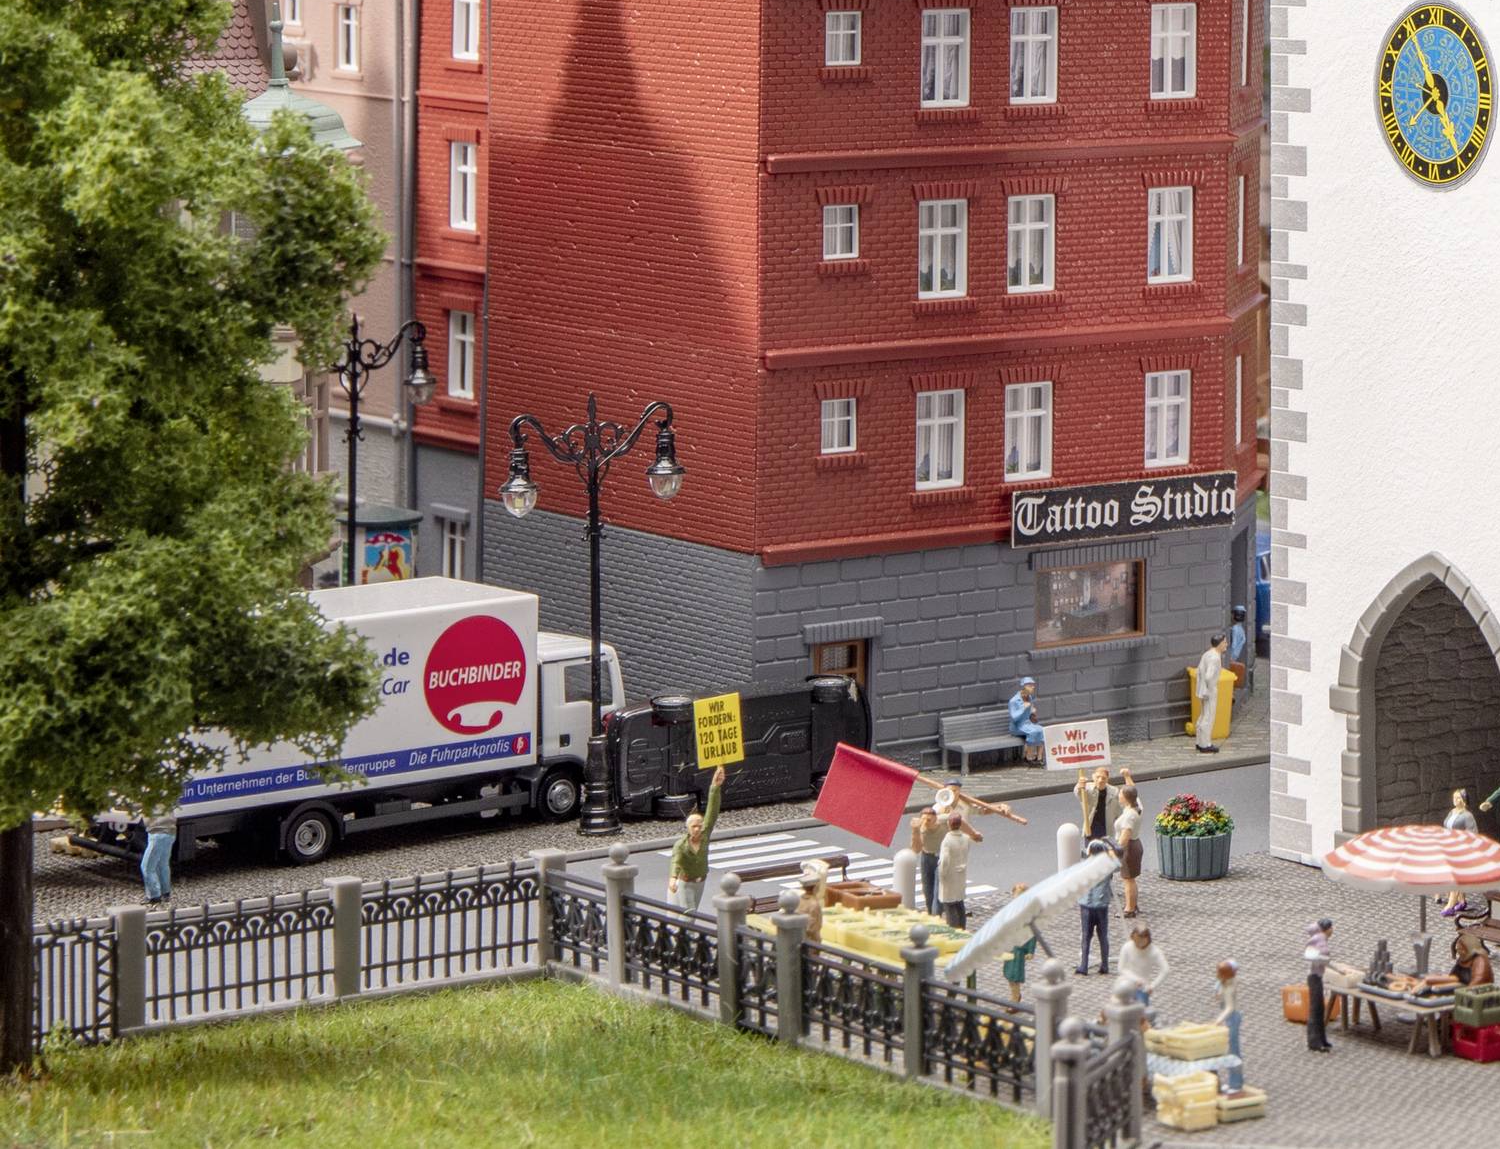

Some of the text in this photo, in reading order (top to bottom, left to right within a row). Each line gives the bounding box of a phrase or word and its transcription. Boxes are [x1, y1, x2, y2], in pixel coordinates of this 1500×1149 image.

[1015, 480, 1236, 536] Tattoo Studio
[428, 660, 522, 690] BUCHBINDER
[382, 677, 411, 695] Car
[708, 700, 725, 713] WIR
[698, 711, 736, 729] FORDERN:
[699, 727, 738, 745] 120 TAGE
[1064, 729, 1088, 741] Wir
[409, 739, 510, 767] Die Fuhrparkprofis
[703, 741, 737, 760] URLAUB
[1051, 742, 1105, 756] streiken
[197, 774, 273, 796] Unternehmen
[275, 771, 293, 785] der
